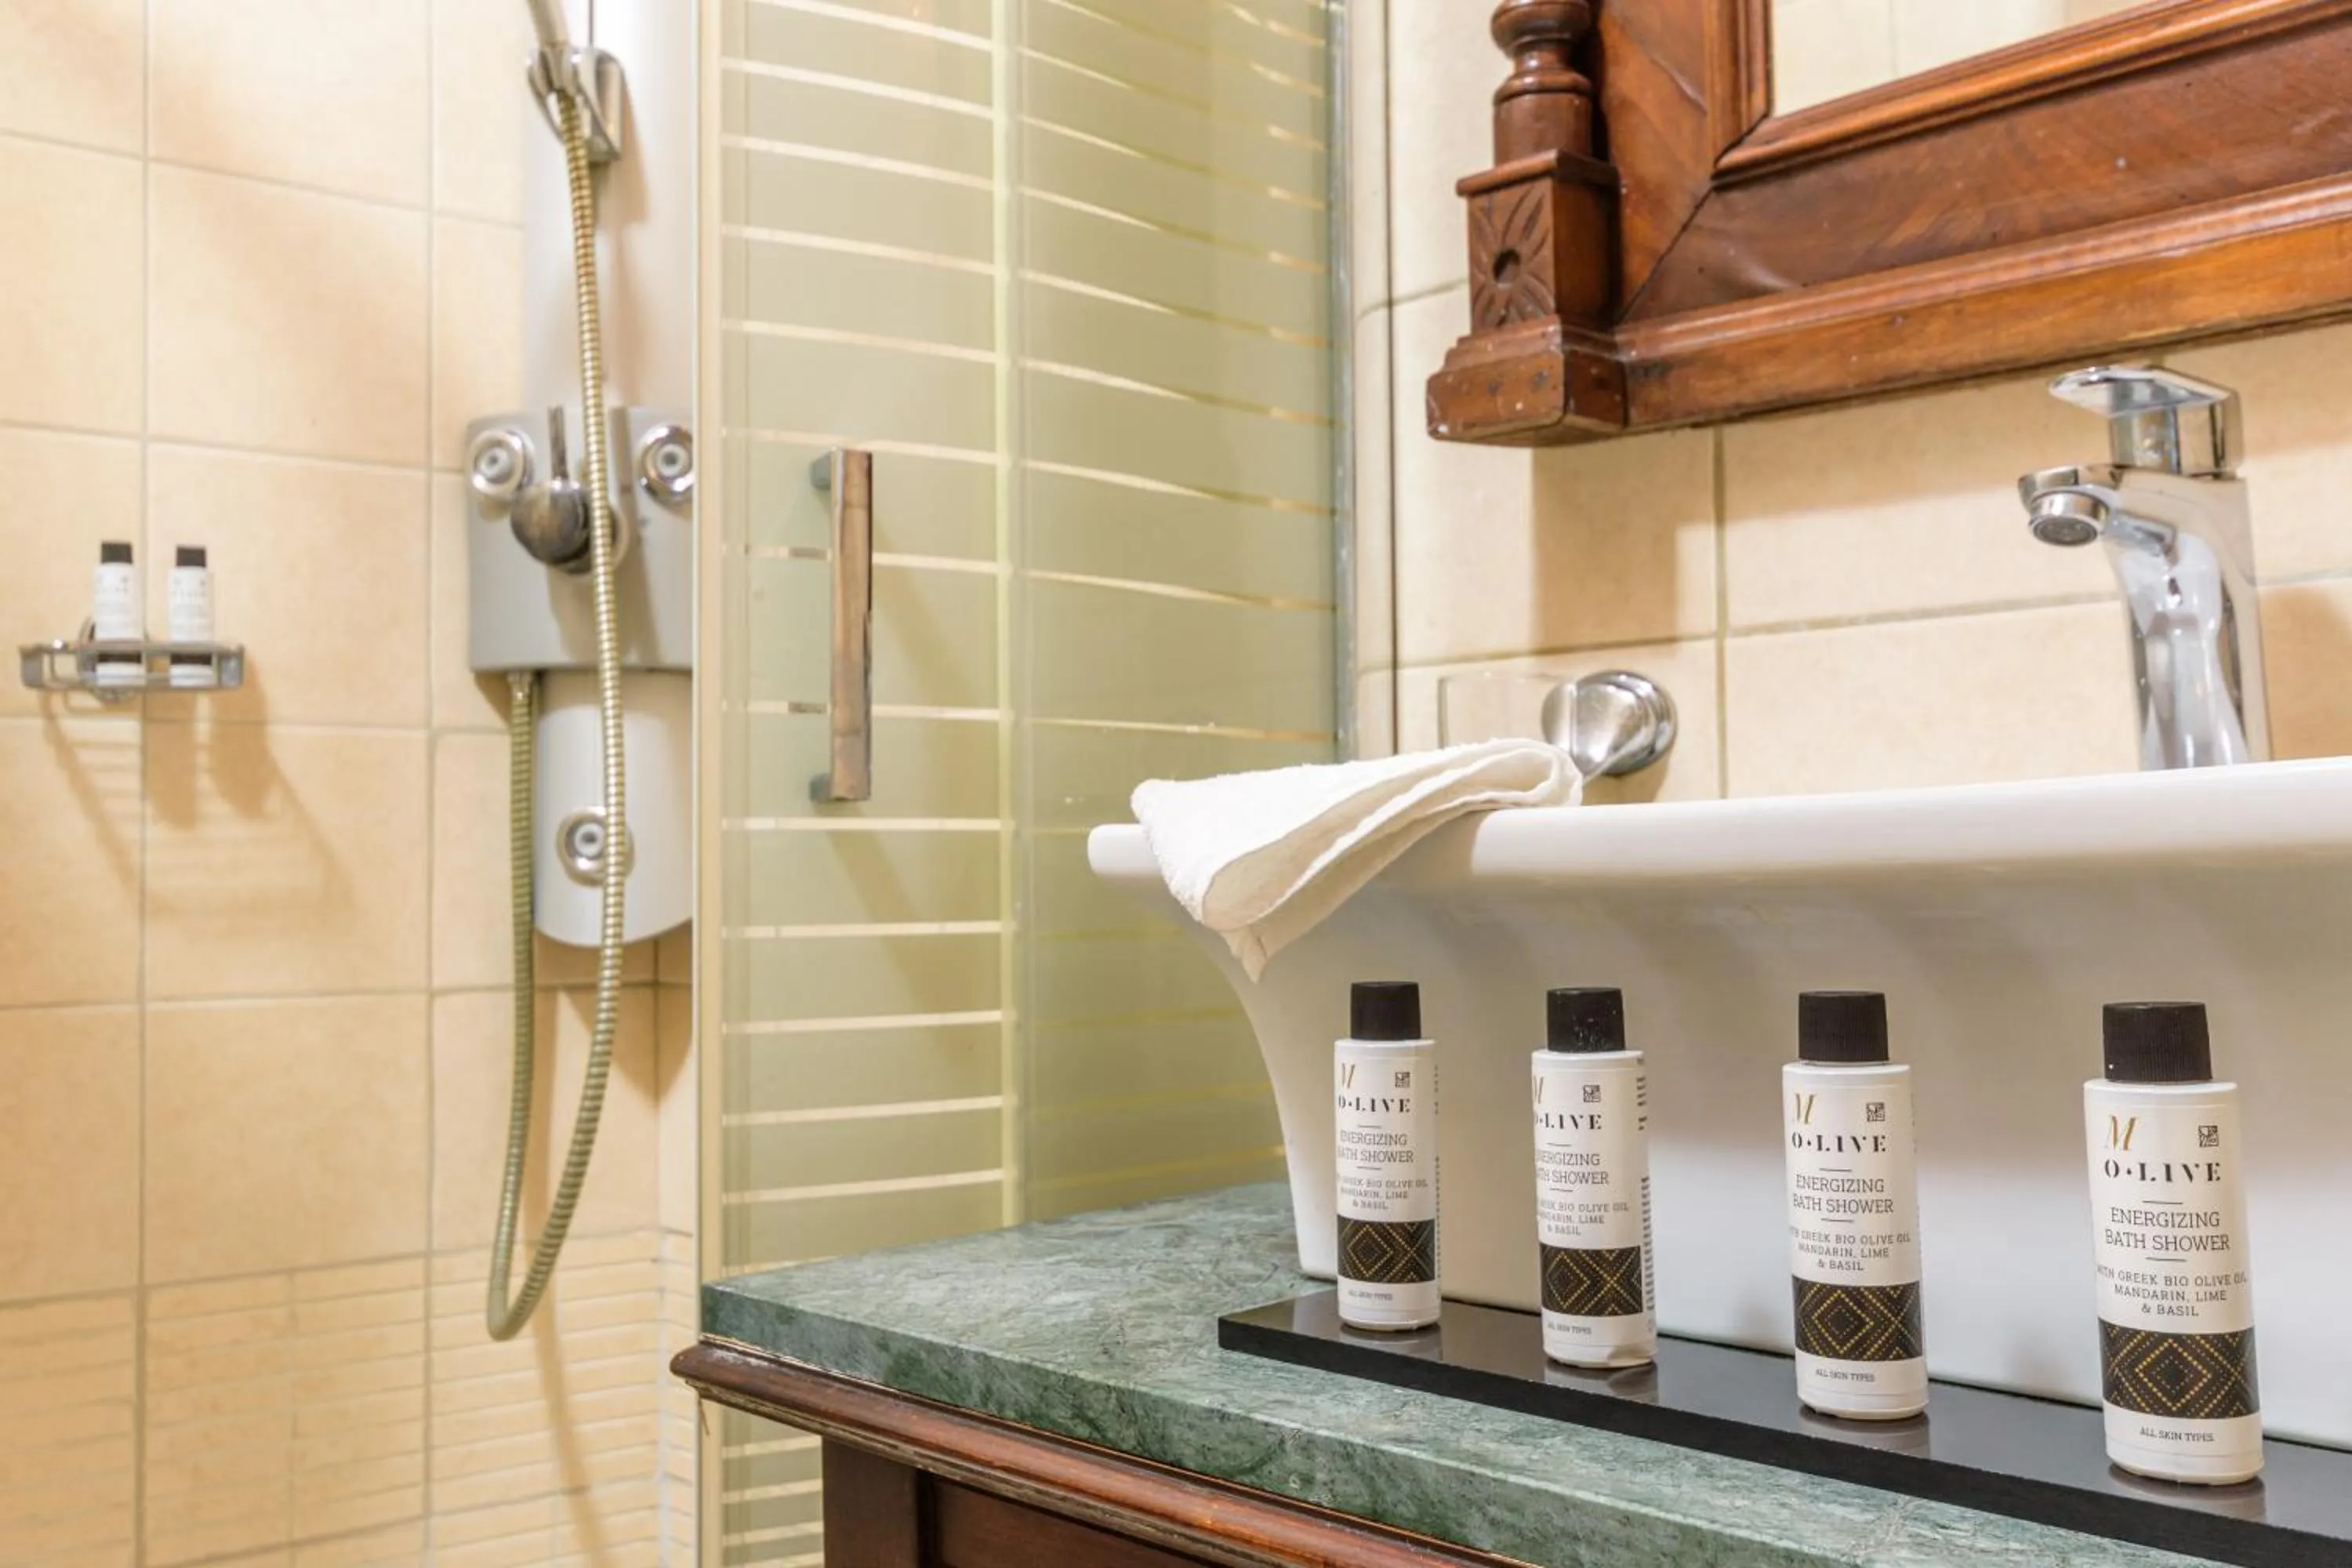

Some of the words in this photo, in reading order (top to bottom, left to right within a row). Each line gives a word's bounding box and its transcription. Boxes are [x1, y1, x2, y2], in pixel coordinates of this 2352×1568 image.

[1360, 1149, 1414, 1163] SHOWER
[1552, 1171, 1610, 1185] SHOWER
[1796, 1174, 1885, 1193] ENERGIZING
[1793, 1193, 1822, 1211] BATH
[1826, 1199, 1894, 1214] SHOWER
[1579, 1214, 1605, 1225] LIME
[2111, 1207, 2220, 1229] ENERGIZING
[1835, 1234, 1856, 1245] BIO
[1860, 1235, 1895, 1246] OLIVE
[2105, 1229, 2146, 1250] BATH
[2152, 1234, 2230, 1252] SHOWER
[1860, 1247, 1889, 1258] LIME
[1829, 1260, 1864, 1272] BASIL
[2118, 1269, 2158, 1285] GREEK
[2164, 1275, 2188, 1287] BIO
[2194, 1274, 2231, 1287] OLIVE
[2114, 1284, 2190, 1303] MANDARIN,
[2196, 1290, 2227, 1302] LIME
[2141, 1304, 2152, 1314] &
[2157, 1305, 2199, 1317] BASIL
[2140, 1426, 2156, 1438] ALL
[2158, 1429, 2182, 1441] SKIN
[2185, 1432, 2214, 1443] TYPES
